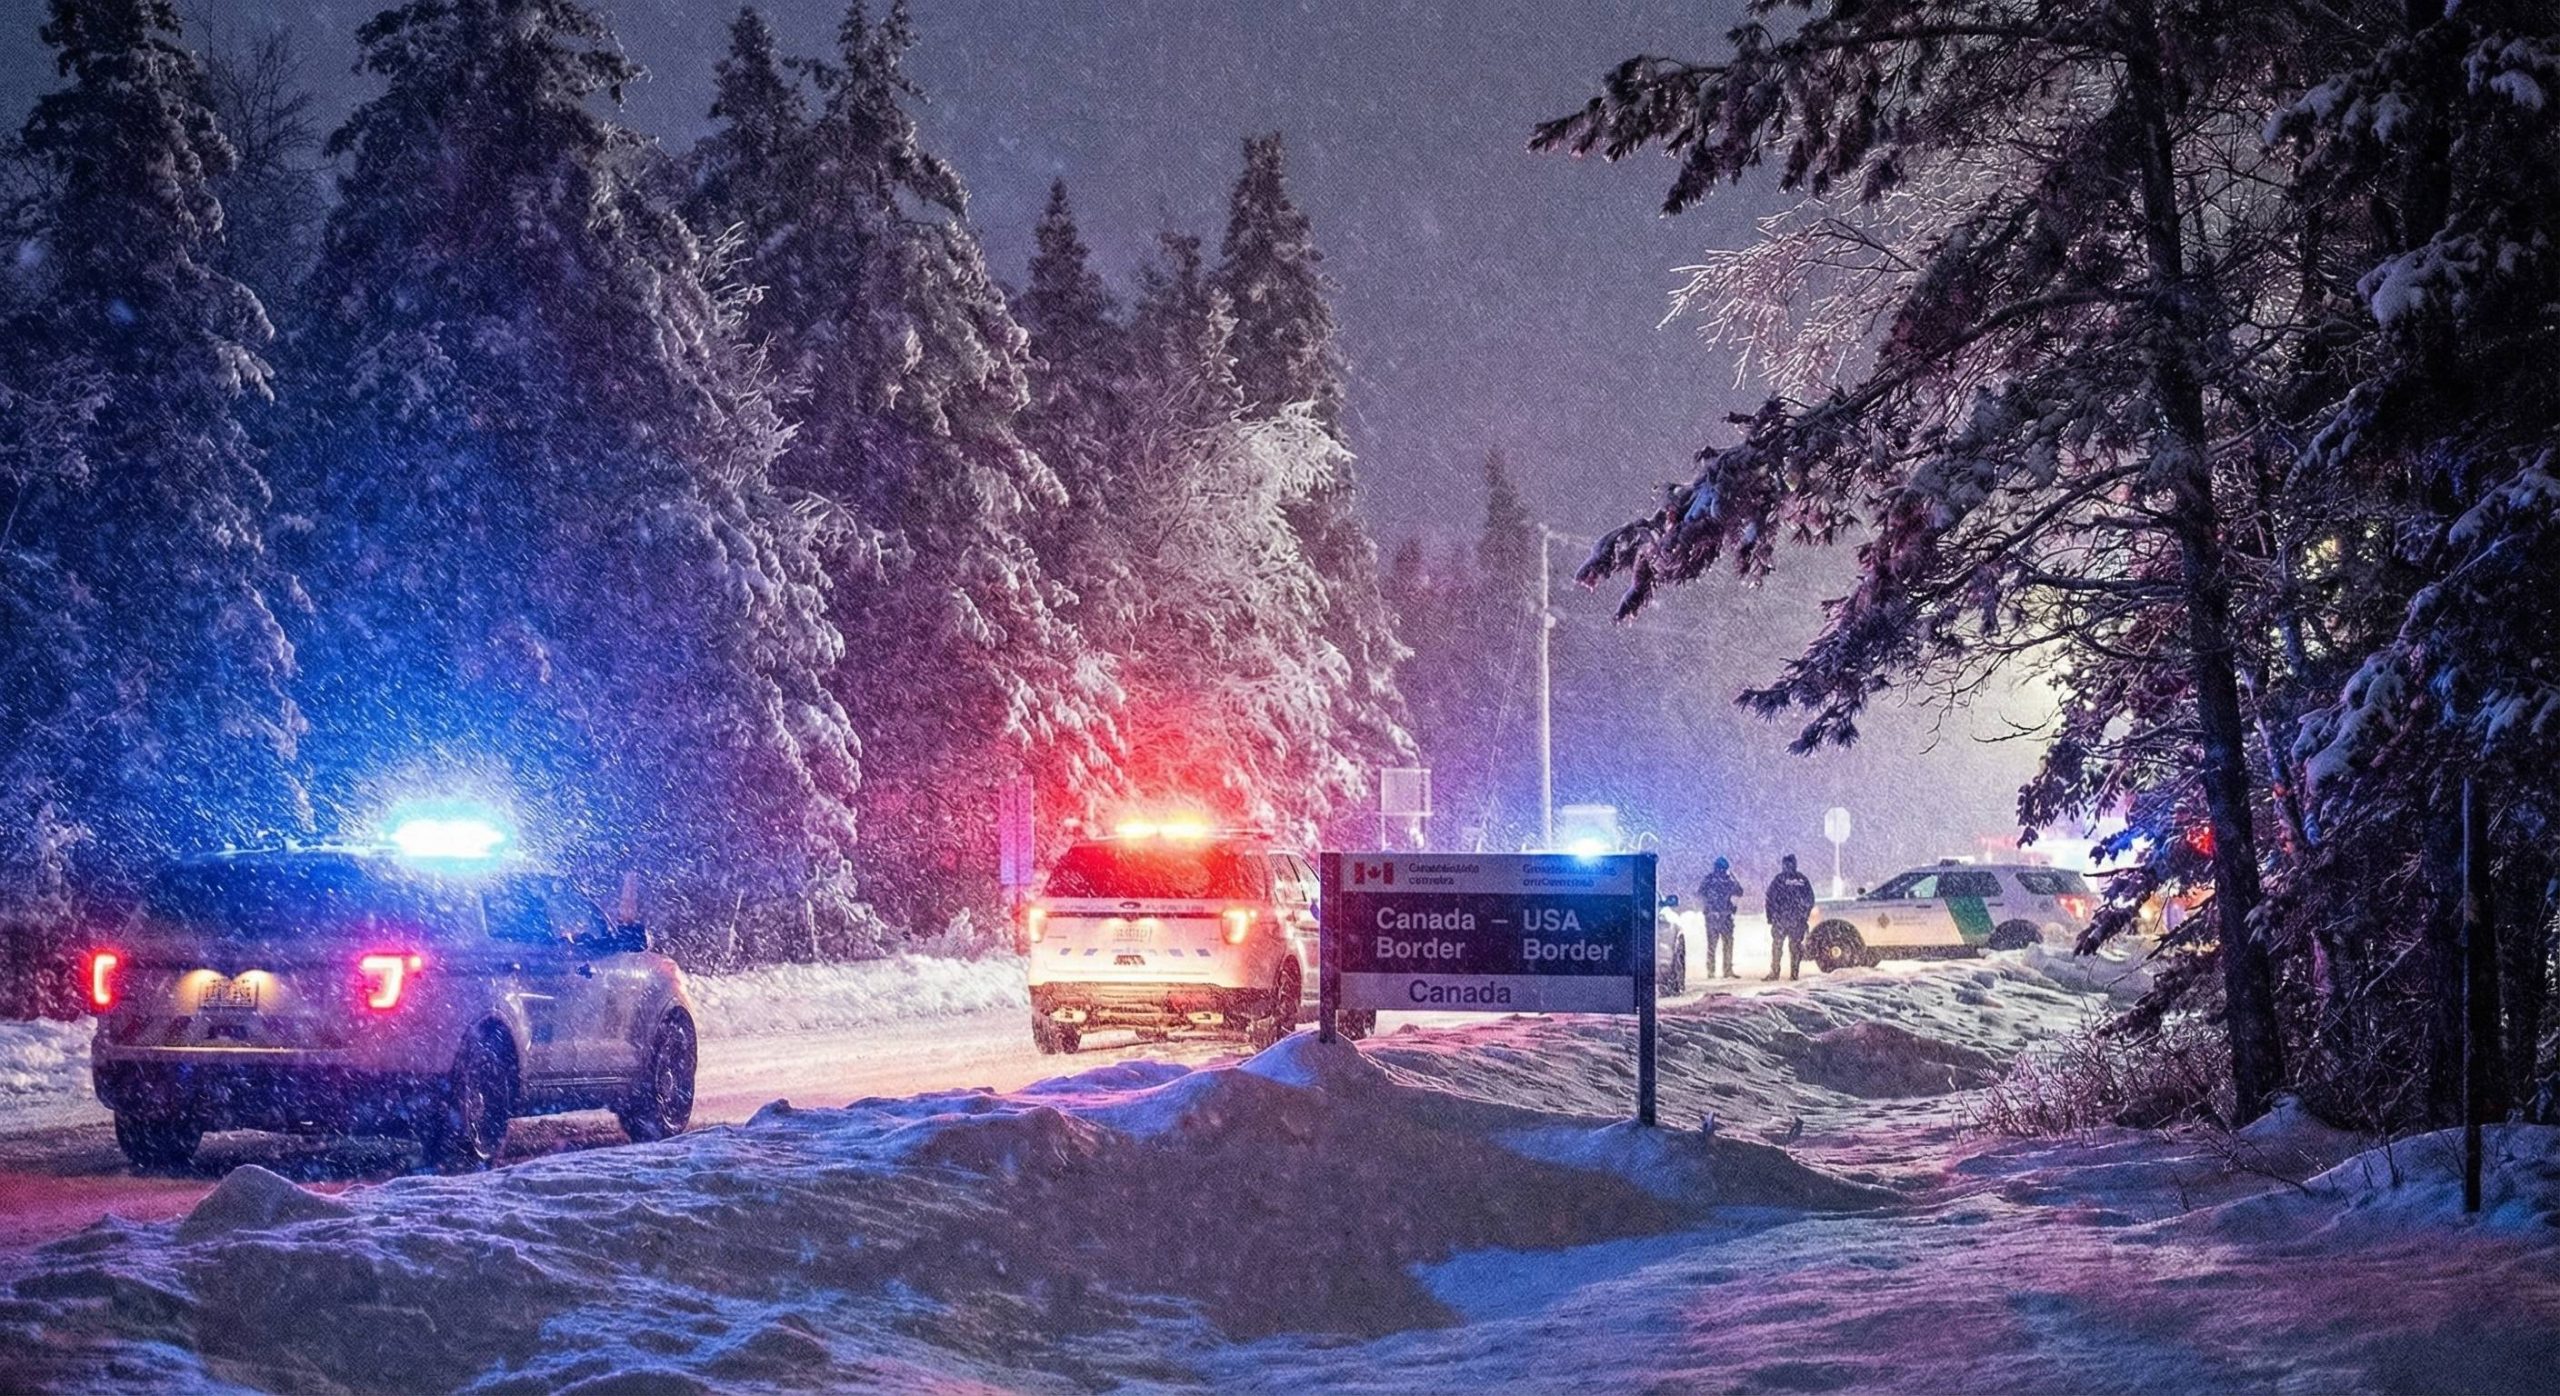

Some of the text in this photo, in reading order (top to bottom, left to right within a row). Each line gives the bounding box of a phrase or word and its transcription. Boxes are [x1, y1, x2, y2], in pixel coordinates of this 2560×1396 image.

[1376, 906, 1476, 931] Canada
[1523, 908, 1582, 931] USA
[1376, 936, 1614, 960] Border Border
[1409, 979, 1512, 1004] Canada
